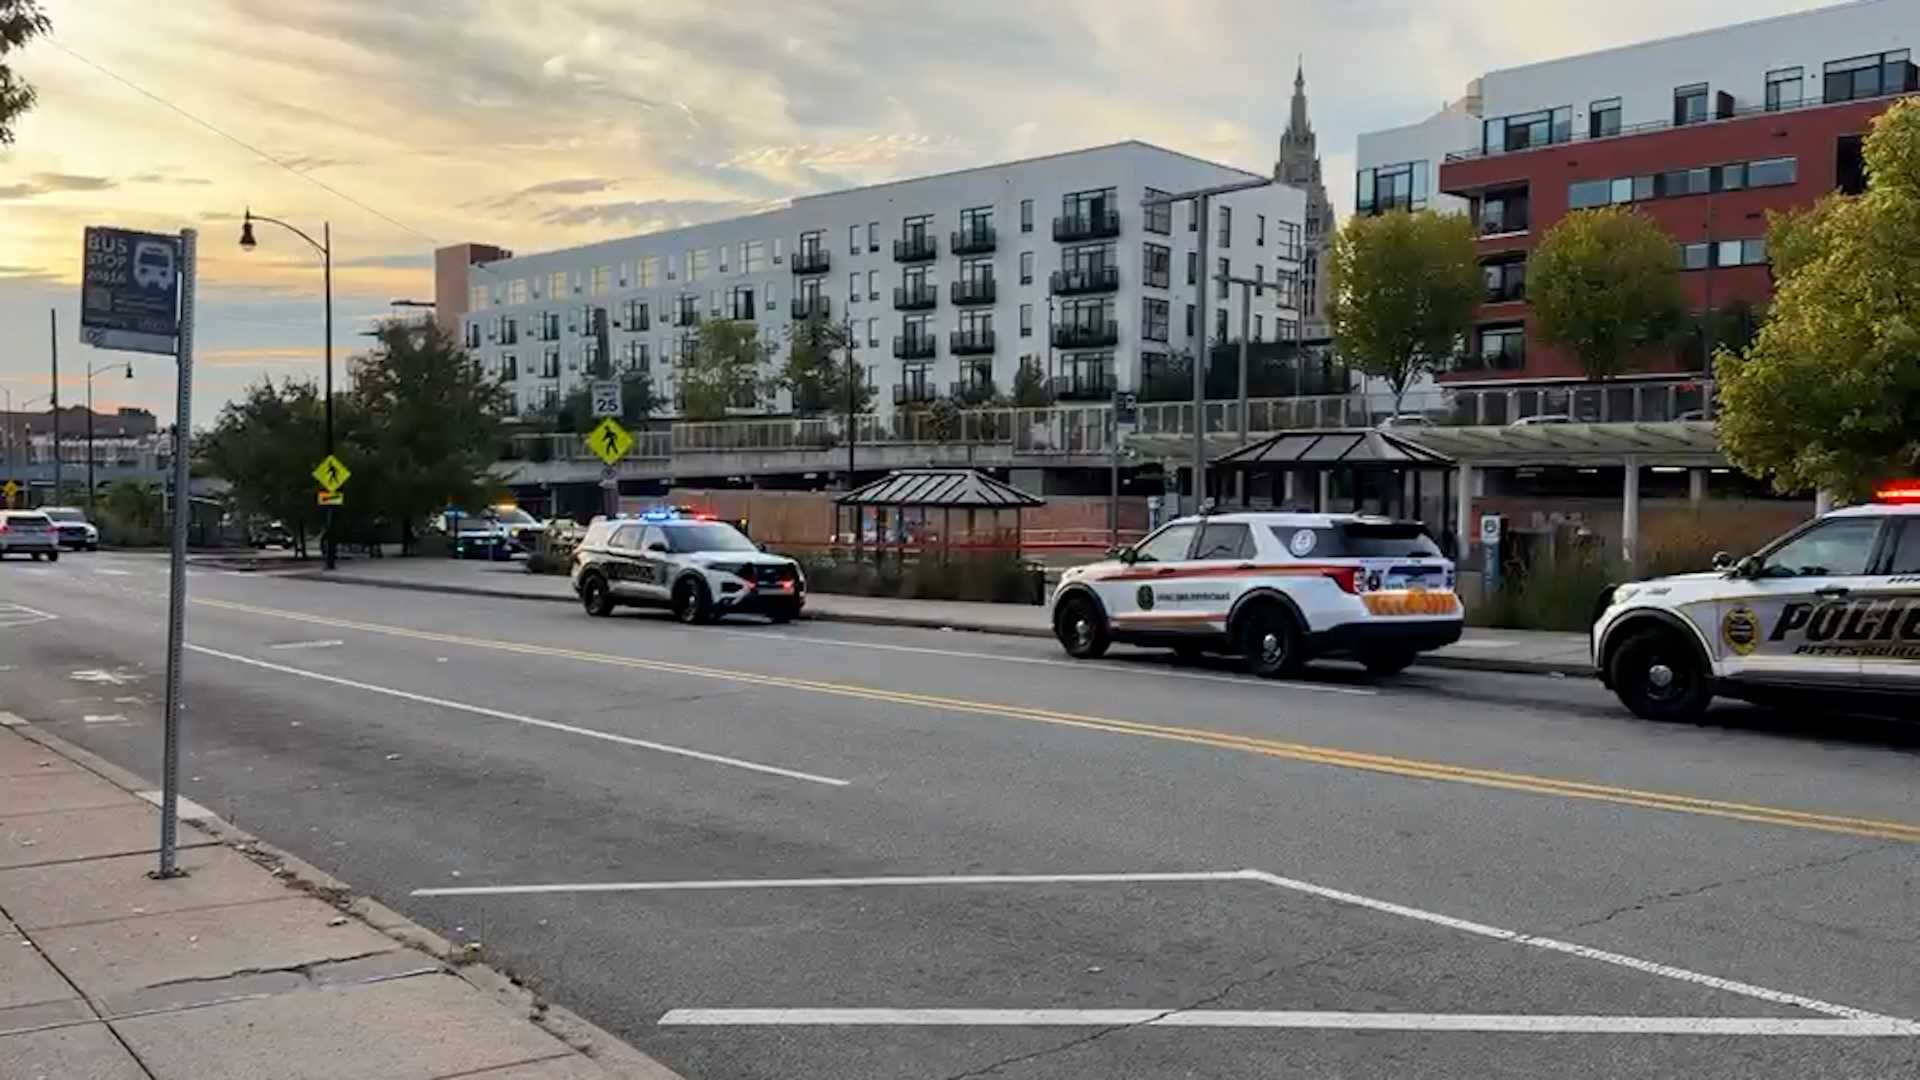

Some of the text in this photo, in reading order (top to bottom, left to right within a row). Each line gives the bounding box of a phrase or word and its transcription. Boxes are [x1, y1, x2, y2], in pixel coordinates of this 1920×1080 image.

[87, 233, 128, 254] BUS
[87, 252, 127, 268] STOP
[597, 398, 618, 411] 25
